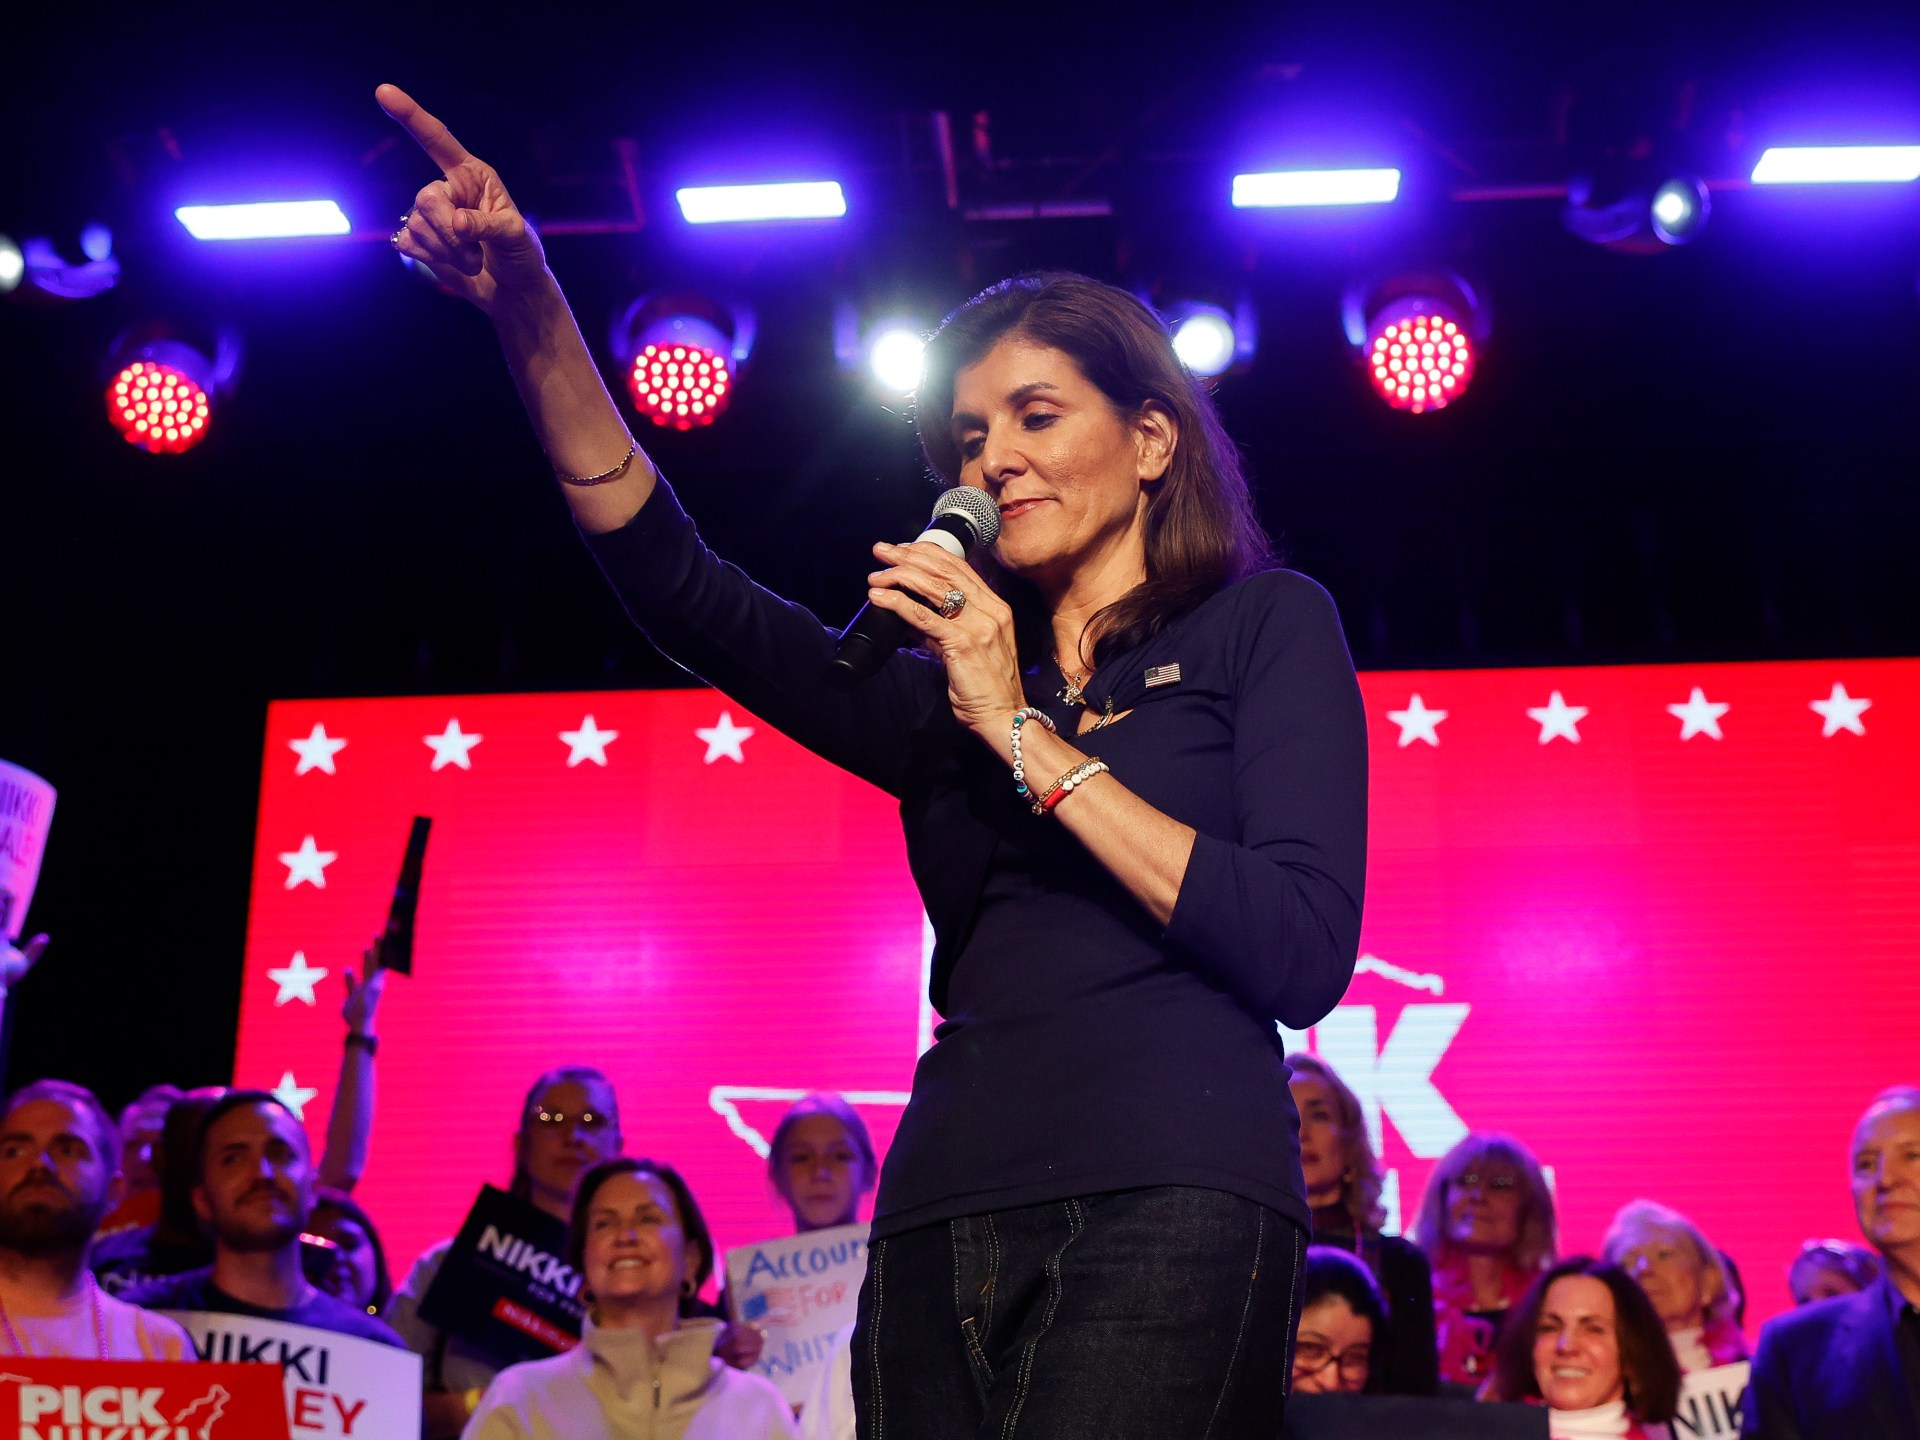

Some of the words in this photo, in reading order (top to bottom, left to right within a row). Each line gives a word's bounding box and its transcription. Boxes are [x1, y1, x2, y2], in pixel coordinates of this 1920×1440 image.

[477, 1224, 583, 1298] NIKKI
[20, 1384, 168, 1427] PICK
[1669, 1387, 1744, 1440] NIK
